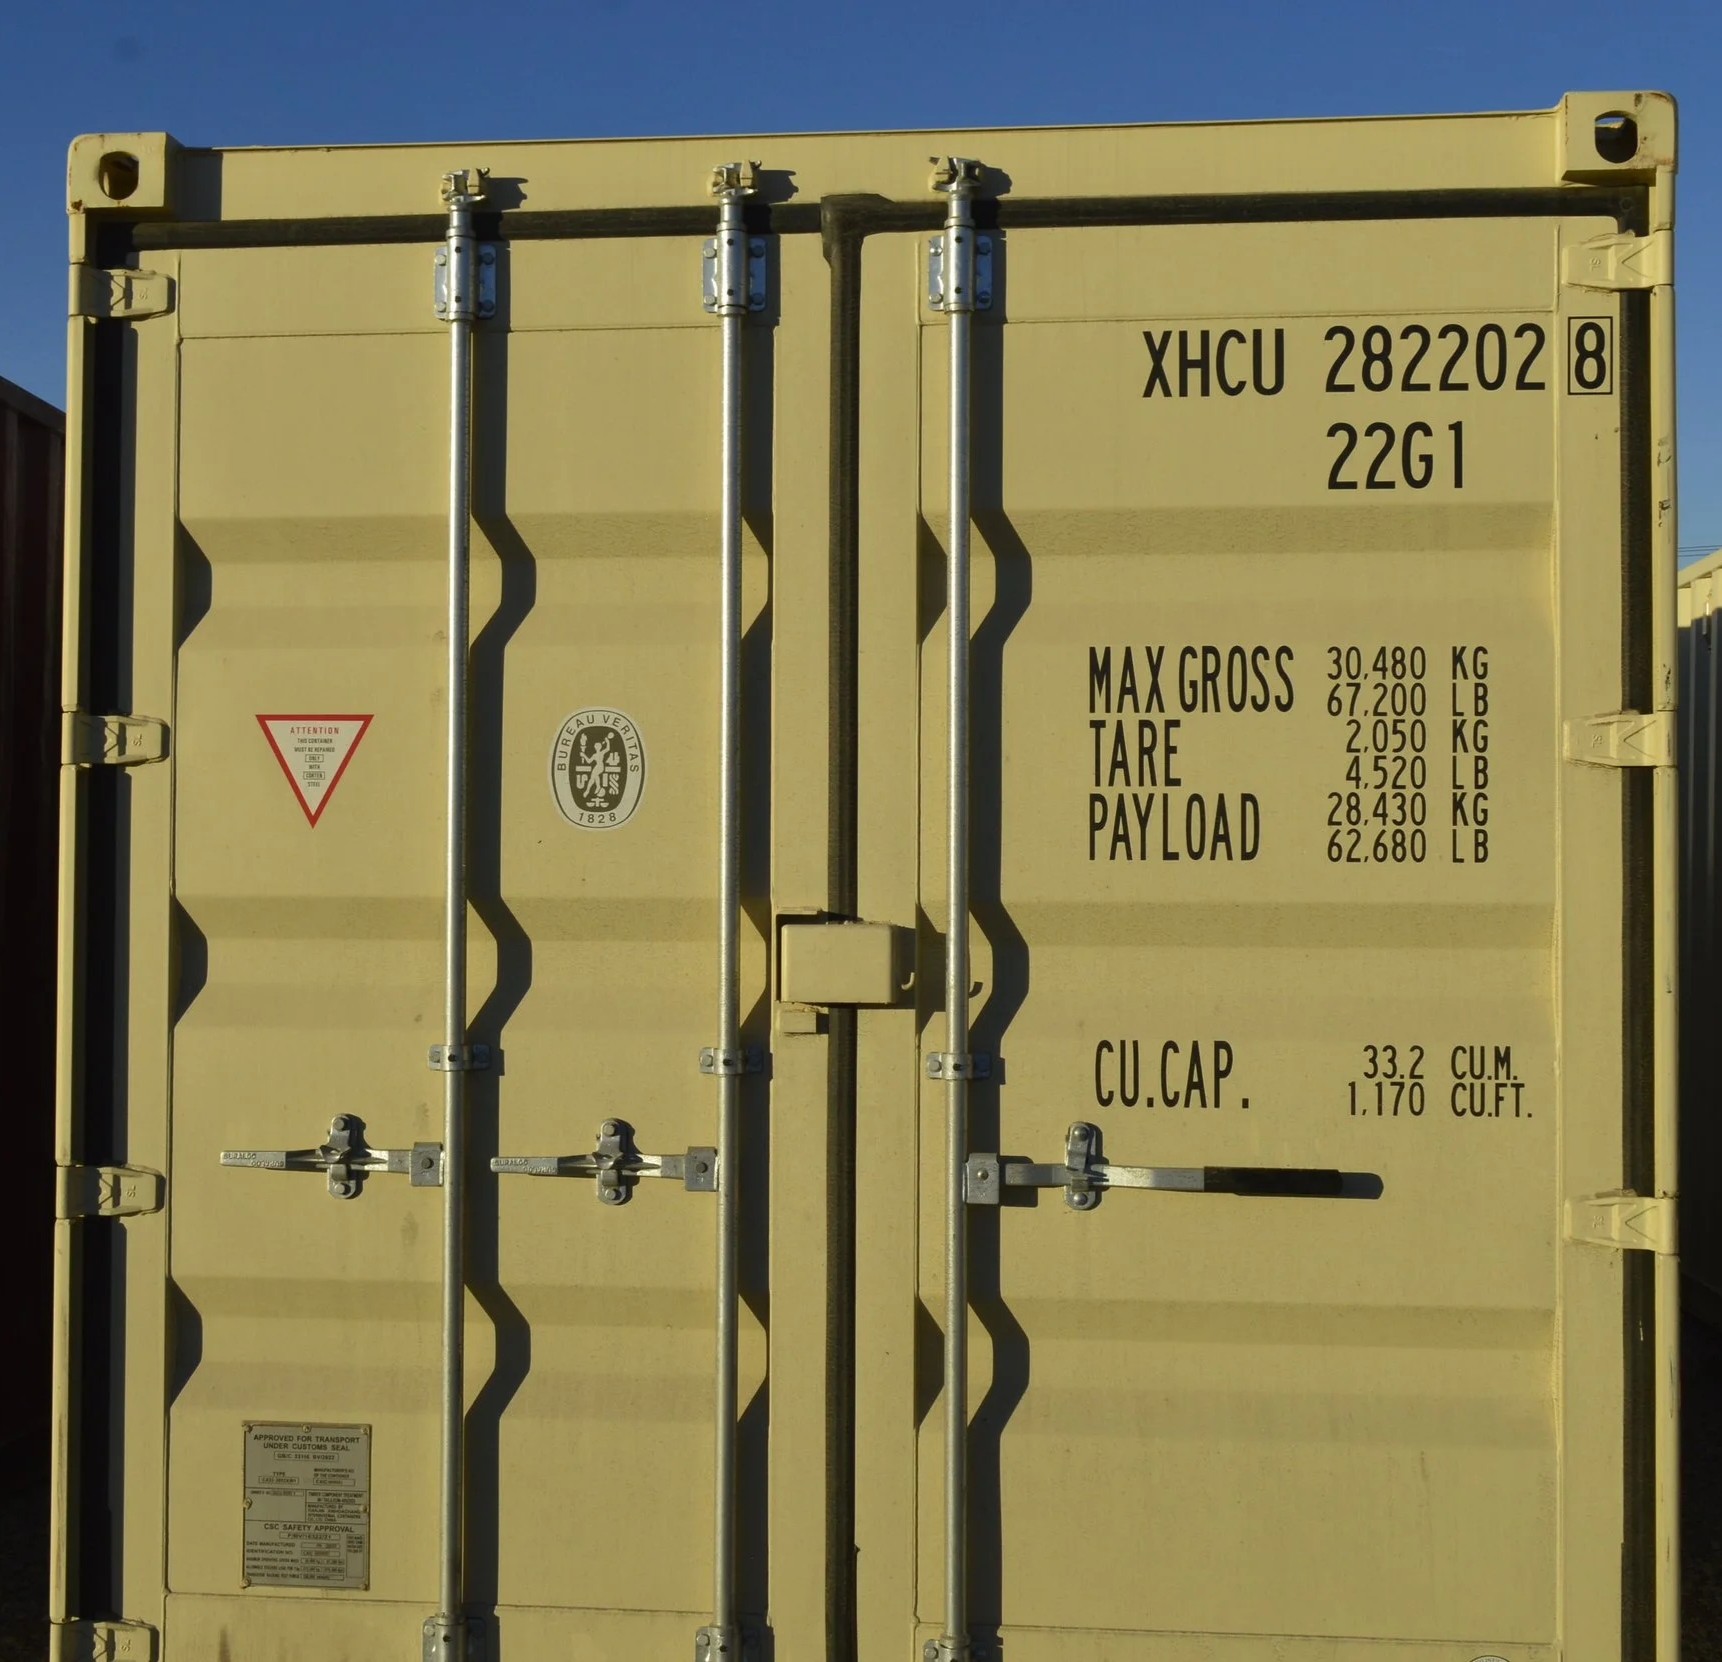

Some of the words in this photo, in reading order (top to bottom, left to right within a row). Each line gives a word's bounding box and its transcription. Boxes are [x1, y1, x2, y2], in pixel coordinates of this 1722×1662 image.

[1143, 329, 1284, 397] XHCU
[1325, 323, 1545, 392] 282202
[1575, 322, 1606, 389] 8
[1327, 421, 1462, 489] 22G1
[1090, 646, 1165, 713] MAX
[1179, 646, 1293, 712] GROSS
[1328, 646, 1425, 680] 30,480
[1453, 646, 1487, 679] KG
[1328, 683, 1426, 716] 67,200
[1453, 683, 1488, 716] LB
[557, 715, 595, 771] BUREAU
[603, 714, 639, 772] VERITAS
[1090, 720, 1181, 786] TARE
[1347, 719, 1426, 753] 2,050
[1453, 719, 1488, 753] KG
[1346, 756, 1426, 789] 4,520
[1453, 756, 1488, 789] LB
[580, 812, 616, 823] 1828
[1090, 793, 1259, 860] PAYLOAD
[1328, 792, 1426, 826] 28,430
[1453, 792, 1488, 826] KG
[1328, 829, 1426, 862] 62,680
[1453, 829, 1488, 863] LB
[1096, 1040, 1248, 1108] CU.CAP.
[1364, 1045, 1424, 1079] 33.2
[1451, 1046, 1517, 1080] CU.M.
[1349, 1082, 1424, 1116] 1,170
[1451, 1083, 1532, 1117] CU.FT.
[254, 1434, 293, 1442] APPROVED
[314, 1525, 354, 1533] APPROVAL
